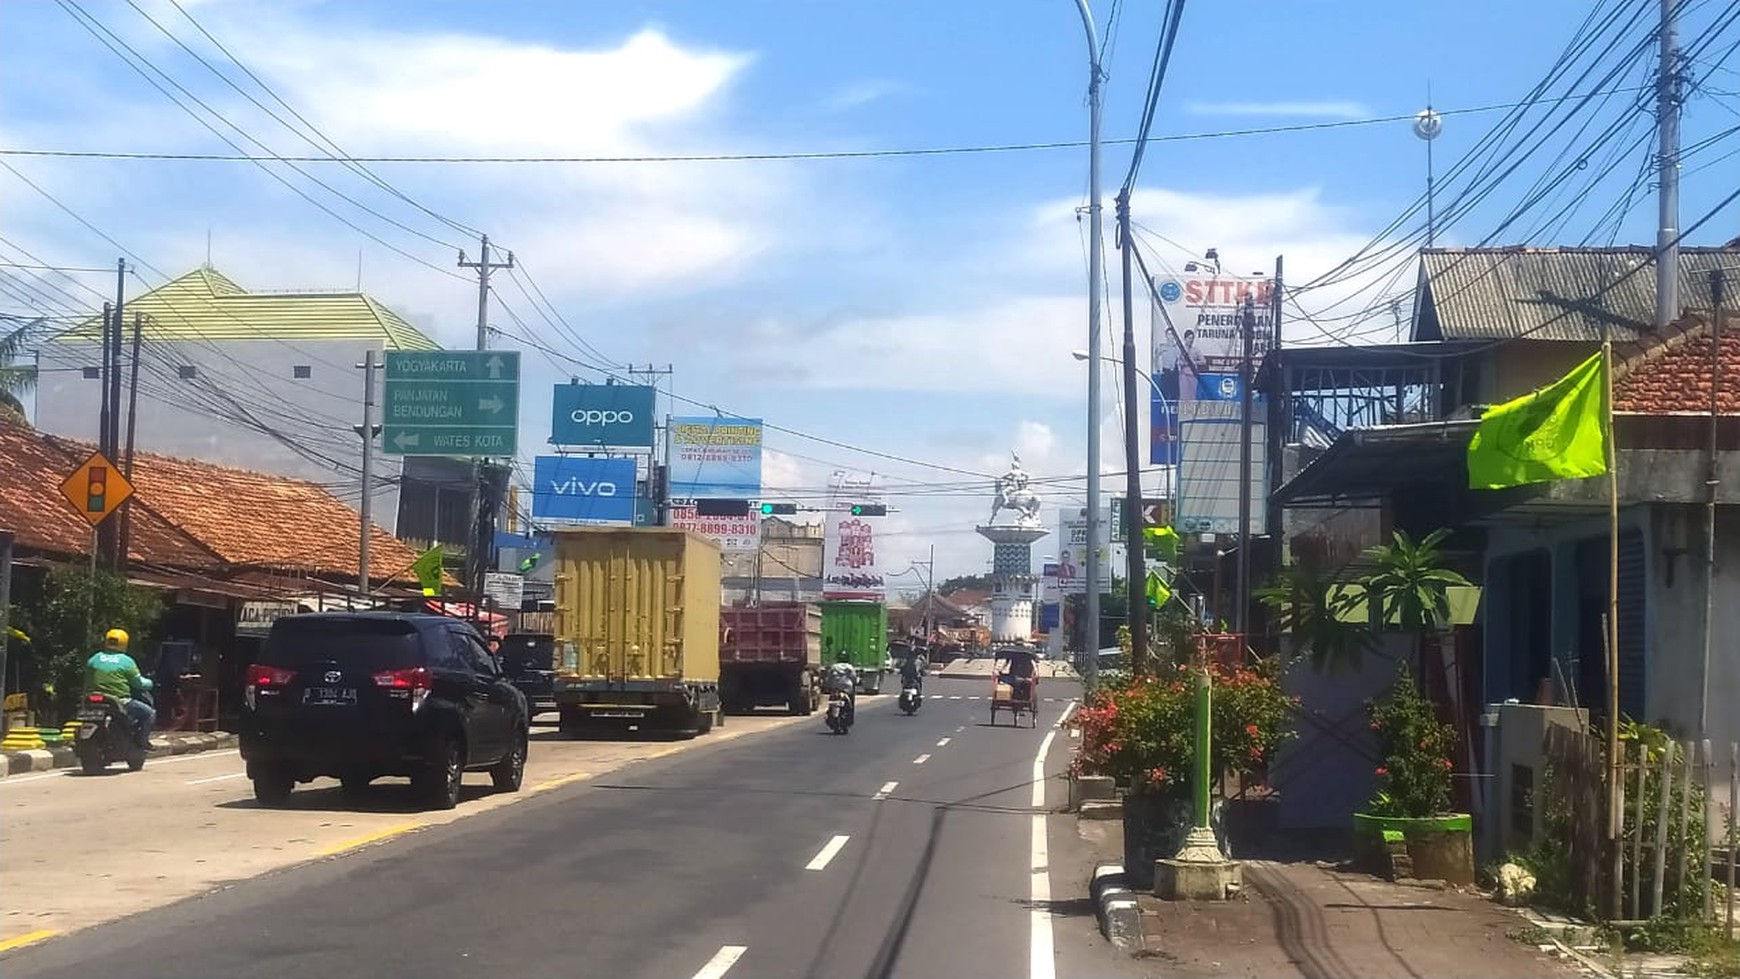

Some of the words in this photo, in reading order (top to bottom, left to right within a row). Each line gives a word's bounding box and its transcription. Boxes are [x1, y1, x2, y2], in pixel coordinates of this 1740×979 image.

[396, 360, 467, 372] YOGYAKARTA
[394, 390, 448, 401] PANJATAN
[393, 405, 462, 417] BENDUNGAN
[571, 410, 633, 426] oppo
[434, 435, 470, 447] WATES
[475, 436, 503, 447] KOTA
[551, 476, 616, 496] vivo
